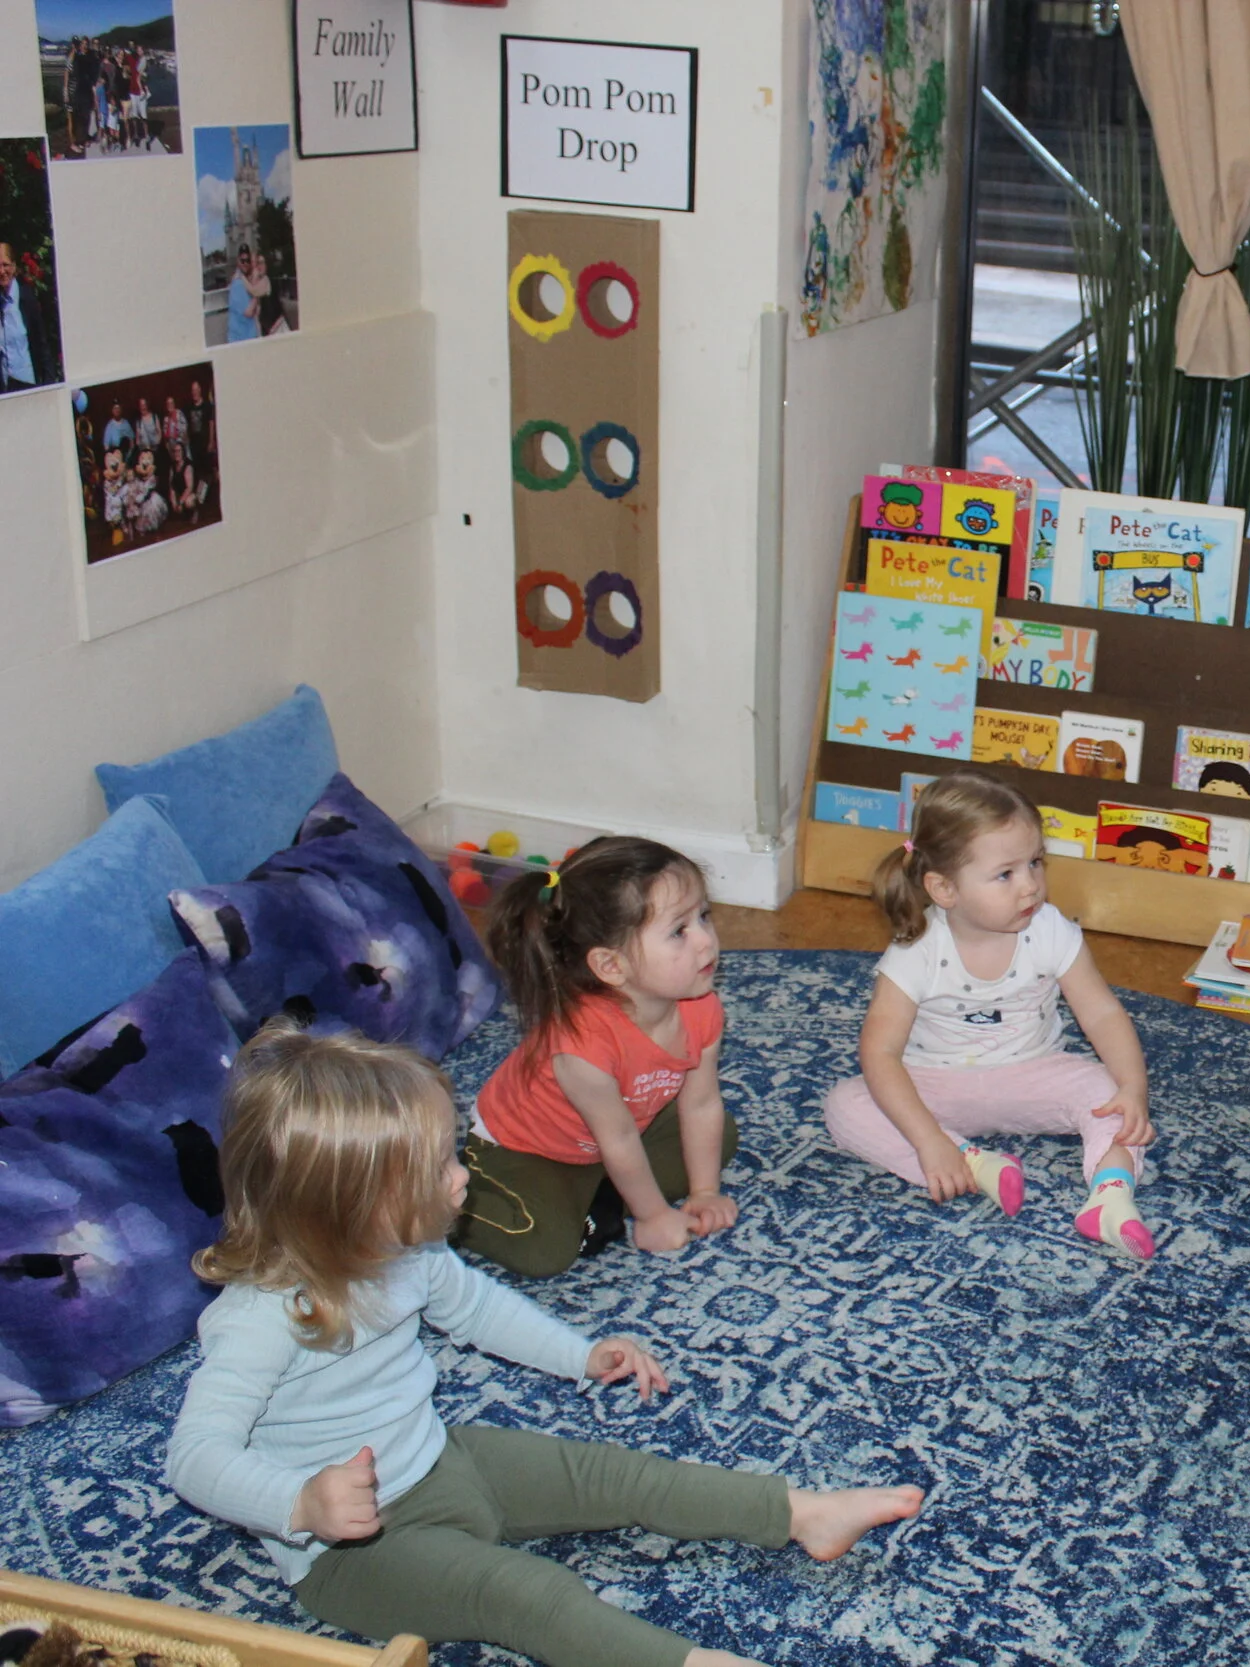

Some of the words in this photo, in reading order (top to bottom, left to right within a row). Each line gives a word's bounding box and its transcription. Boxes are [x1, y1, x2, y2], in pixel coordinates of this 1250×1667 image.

[313, 17, 396, 68] Family
[332, 79, 385, 119] Wall
[520, 72, 592, 110] Pom
[604, 79, 677, 115] Pom
[557, 127, 639, 172] Drop
[1041, 508, 1059, 529] Pe
[1110, 514, 1152, 538] Pete
[1167, 521, 1203, 543] Cat
[880, 545, 929, 574] Pete
[931, 555, 946, 567] the
[947, 557, 988, 583] Cat
[1141, 553, 1160, 567] BUS
[993, 659, 1023, 684] MY
[1030, 659, 1087, 691] BODY
[988, 716, 1030, 732] PUMPKIN
[1190, 738, 1244, 760] Sharing
